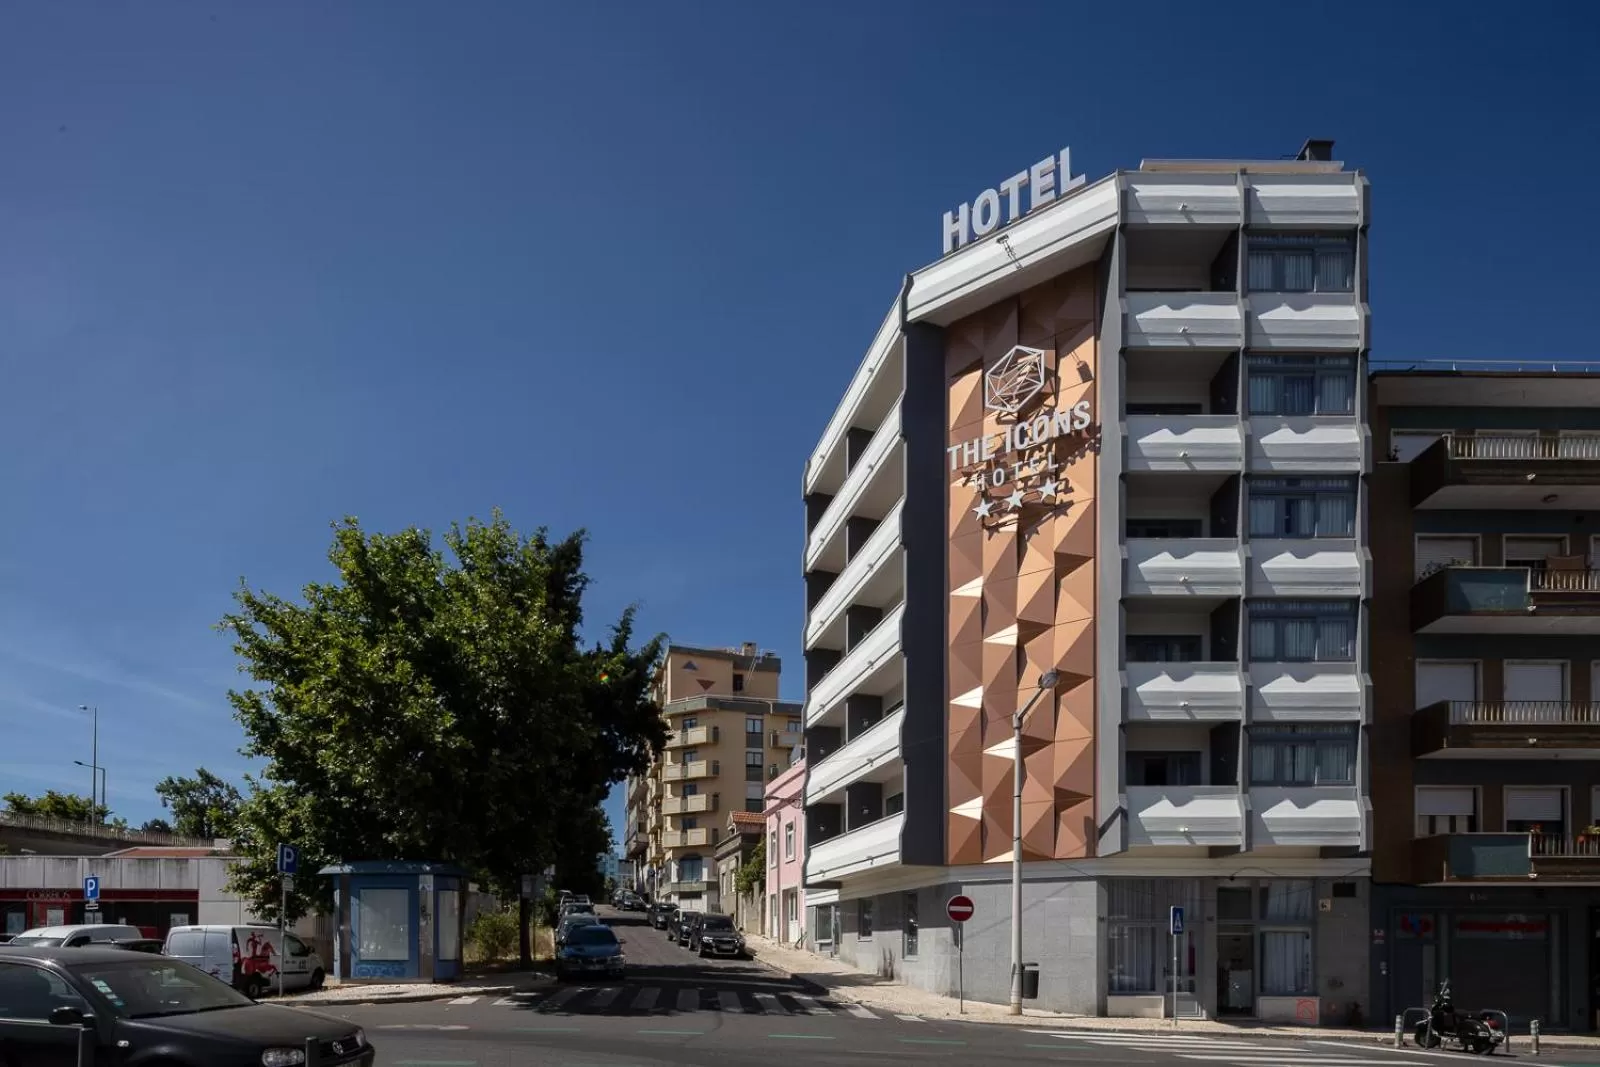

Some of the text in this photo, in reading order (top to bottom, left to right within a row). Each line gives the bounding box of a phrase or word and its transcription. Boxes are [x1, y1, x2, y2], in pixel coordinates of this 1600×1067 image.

[943, 146, 1086, 255] HOTEL
[947, 400, 1091, 471] THE ICONS
[972, 452, 1059, 491] HOTEL
[282, 847, 294, 870] P
[87, 878, 96, 897] P
